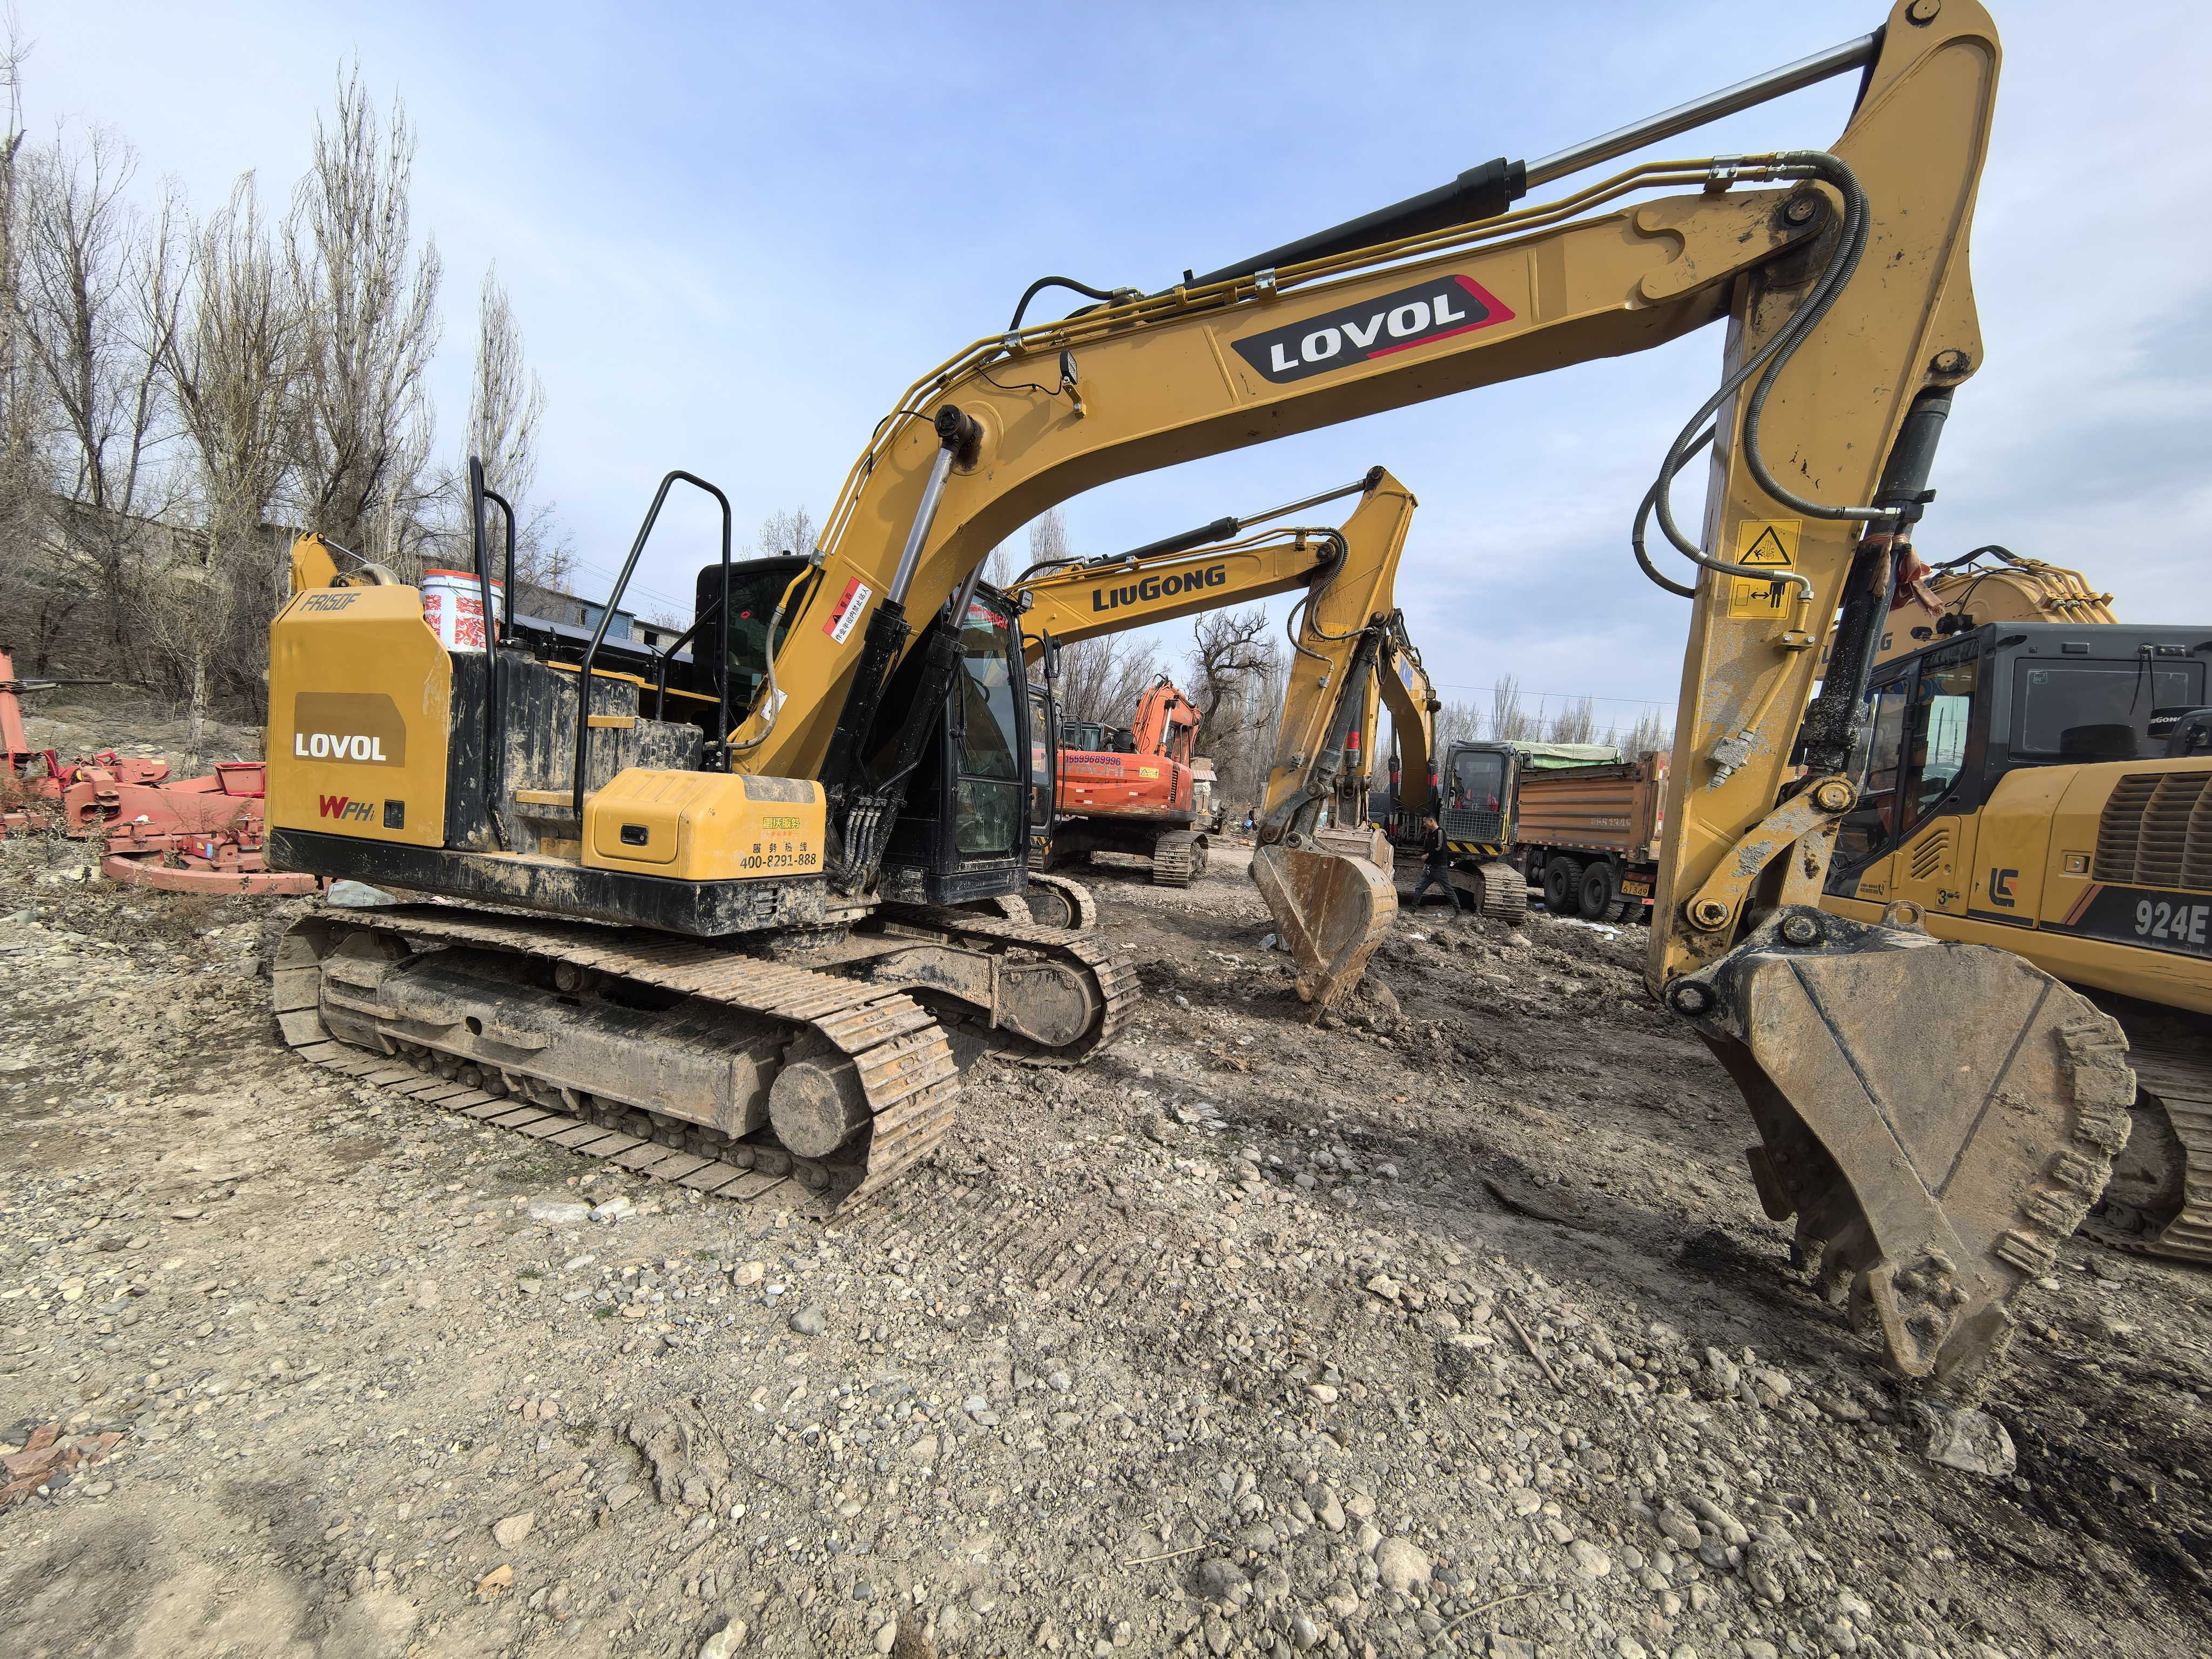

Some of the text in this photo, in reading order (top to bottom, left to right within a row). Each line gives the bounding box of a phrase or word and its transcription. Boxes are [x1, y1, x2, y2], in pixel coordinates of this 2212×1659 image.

[1271, 294, 1465, 372] LOVOL
[835, 588, 869, 641] 作业半径内禁止站人
[295, 733, 386, 761] LOVOL
[1065, 755, 1121, 766] 15599689996
[763, 817, 800, 829] 雷沃服务
[753, 842, 807, 853] 服务热线
[740, 853, 817, 869] 400-8291-888
[2135, 900, 2210, 945] 924E
